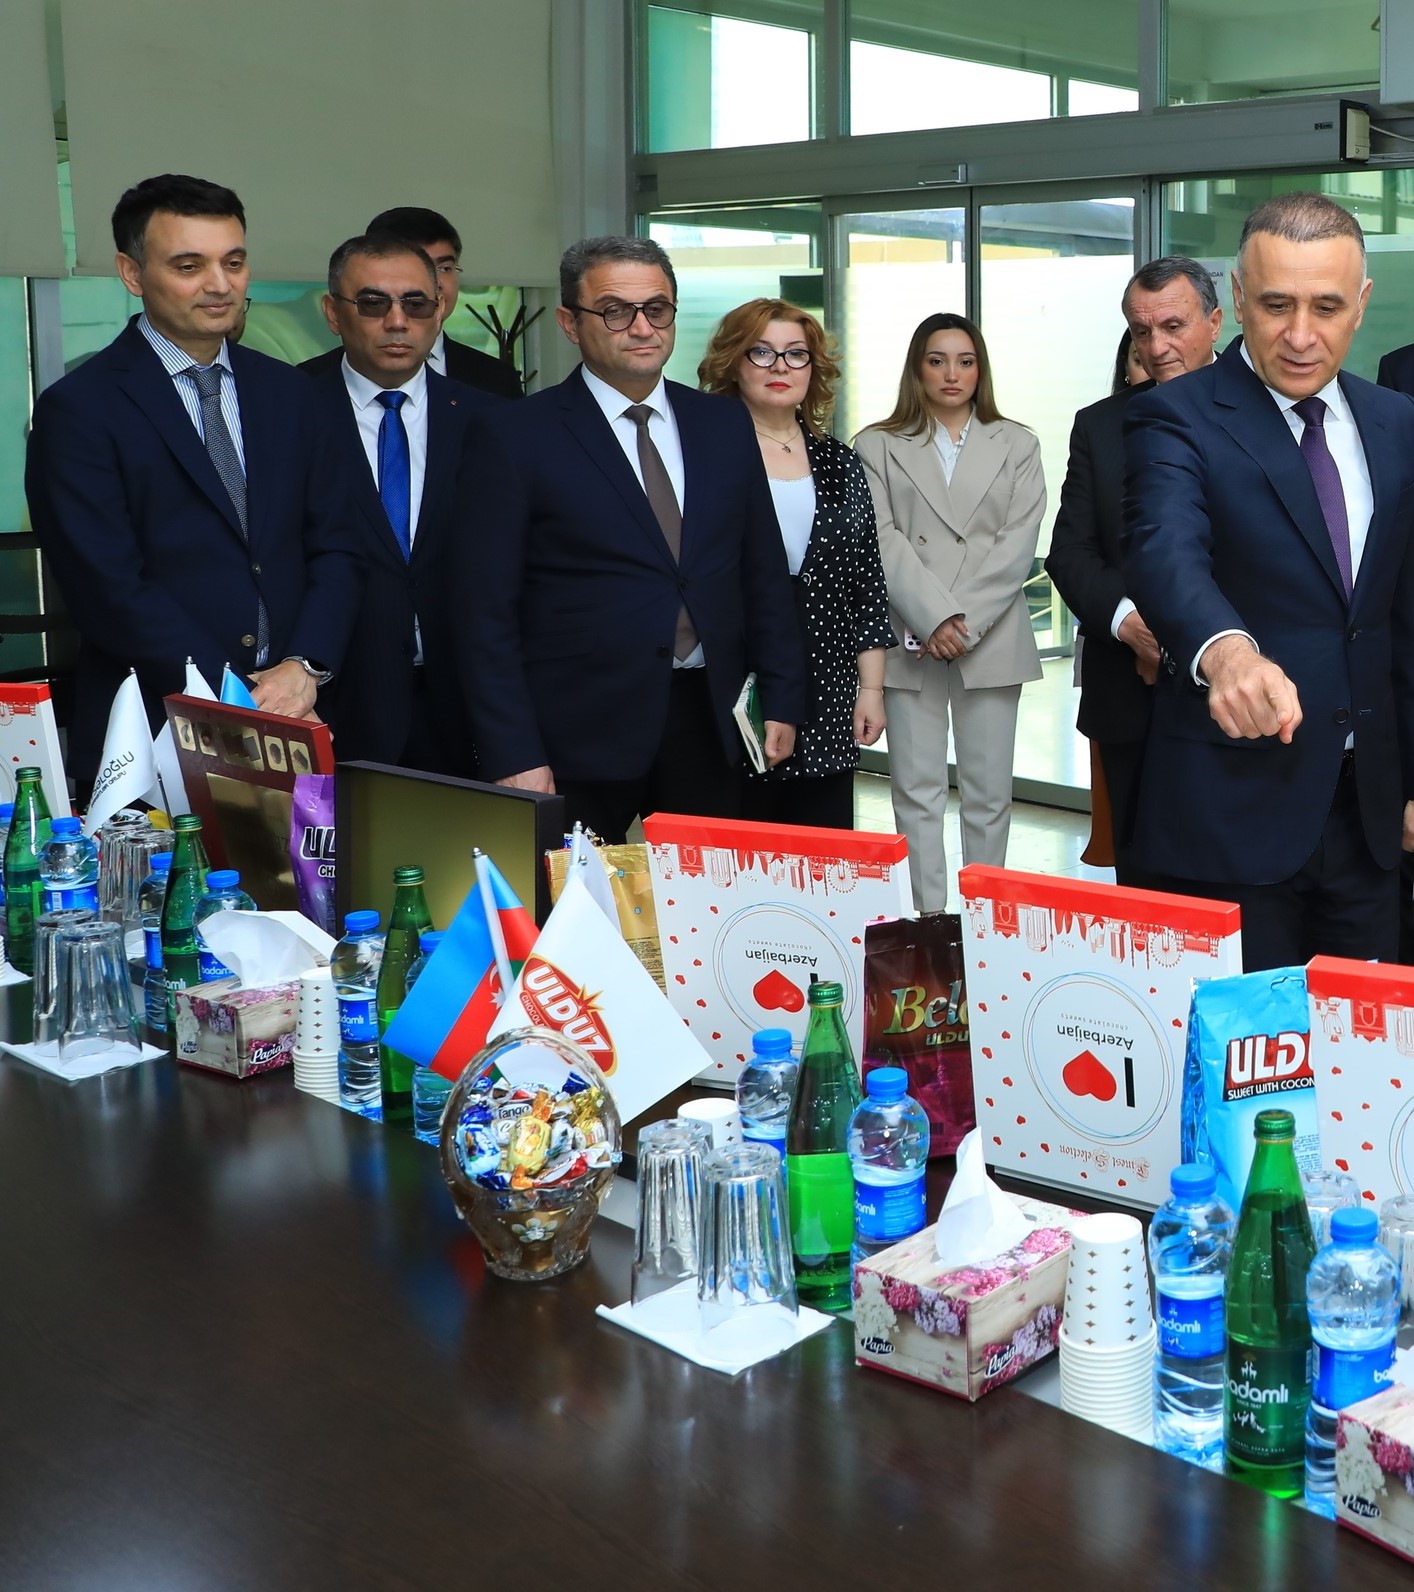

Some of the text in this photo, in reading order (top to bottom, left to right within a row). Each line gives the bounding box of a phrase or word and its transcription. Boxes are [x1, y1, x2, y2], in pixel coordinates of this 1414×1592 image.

[745, 949, 817, 967] Azerbaijan
[521, 995, 545, 1027] CHOCOLA
[526, 964, 612, 1051] ULDUZ
[926, 1030, 969, 1046] ULDU
[1057, 1025, 1134, 1050] Azerbaijan
[250, 1043, 283, 1065] Papia
[1230, 1032, 1314, 1084] ULD
[1227, 1077, 1315, 1100] SWEET WITH COCON
[1159, 1317, 1201, 1334] adamlı
[862, 1336, 895, 1354] Papia
[983, 1344, 1017, 1378] Papia
[1342, 1494, 1381, 1518] Papia
